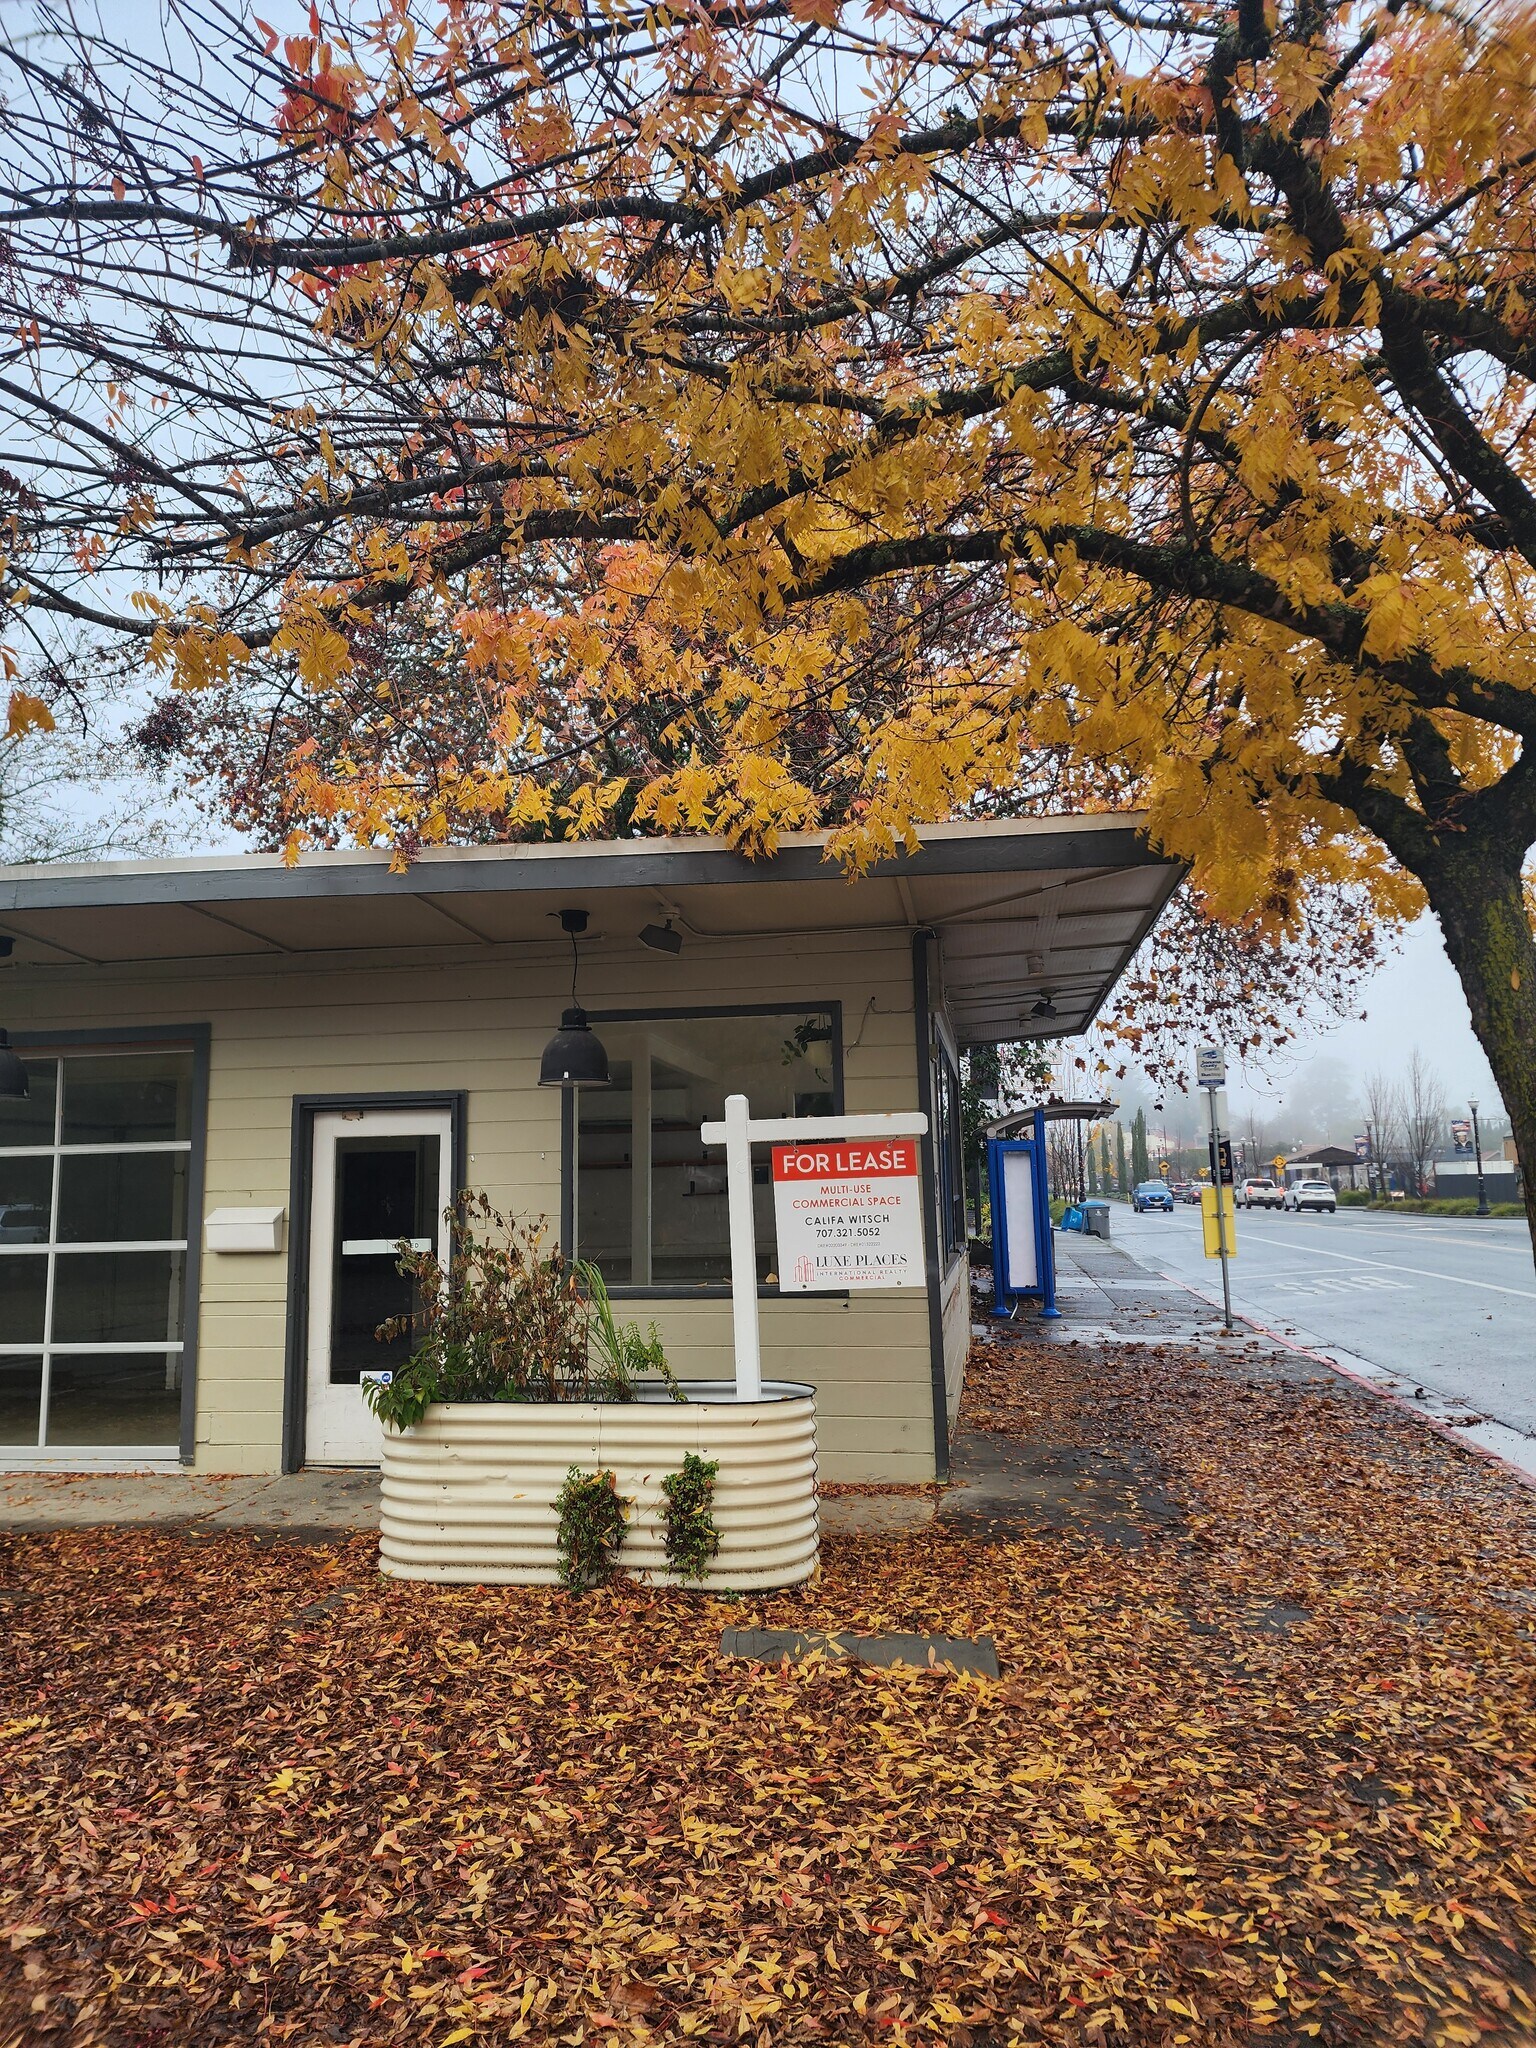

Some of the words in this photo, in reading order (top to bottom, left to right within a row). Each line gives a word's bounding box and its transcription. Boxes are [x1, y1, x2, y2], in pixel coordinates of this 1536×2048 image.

[783, 1153, 830, 1174] FOR
[836, 1150, 907, 1172] LEASE
[820, 1184, 872, 1195] MULTI-USE
[792, 1197, 865, 1209] COMMERCIAL
[867, 1196, 901, 1206] SPACE
[805, 1216, 845, 1226] CALIFA
[848, 1214, 890, 1224] WITSCH
[816, 1227, 880, 1238] 707.321.5052
[816, 1255, 852, 1268] LUXE
[856, 1253, 908, 1267] PLACES
